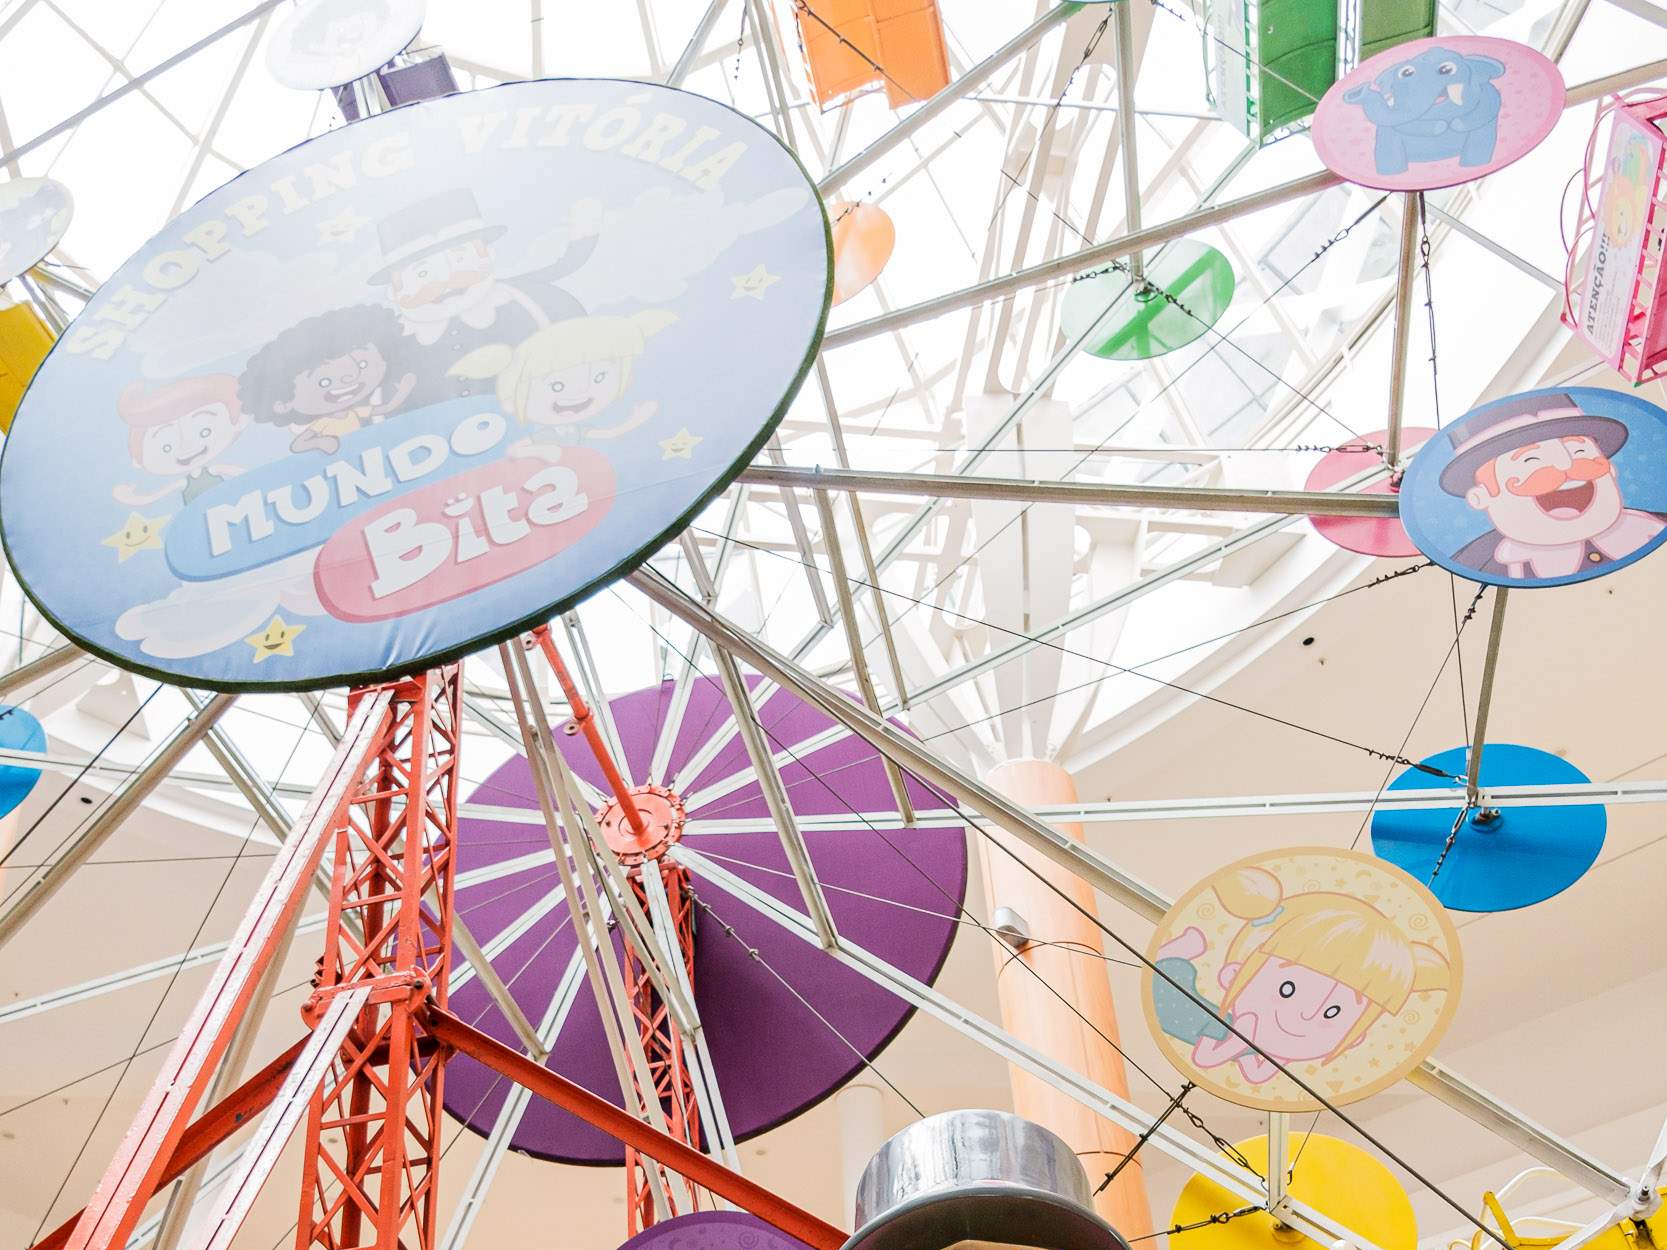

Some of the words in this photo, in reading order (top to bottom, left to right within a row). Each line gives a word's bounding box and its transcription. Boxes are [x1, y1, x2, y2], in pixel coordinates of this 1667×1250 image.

[66, 132, 416, 360] SHOPPING
[457, 91, 750, 192] VITÓRIA
[1587, 232, 1611, 336] ATENÇÃO!!!
[206, 412, 507, 558] MUNDO
